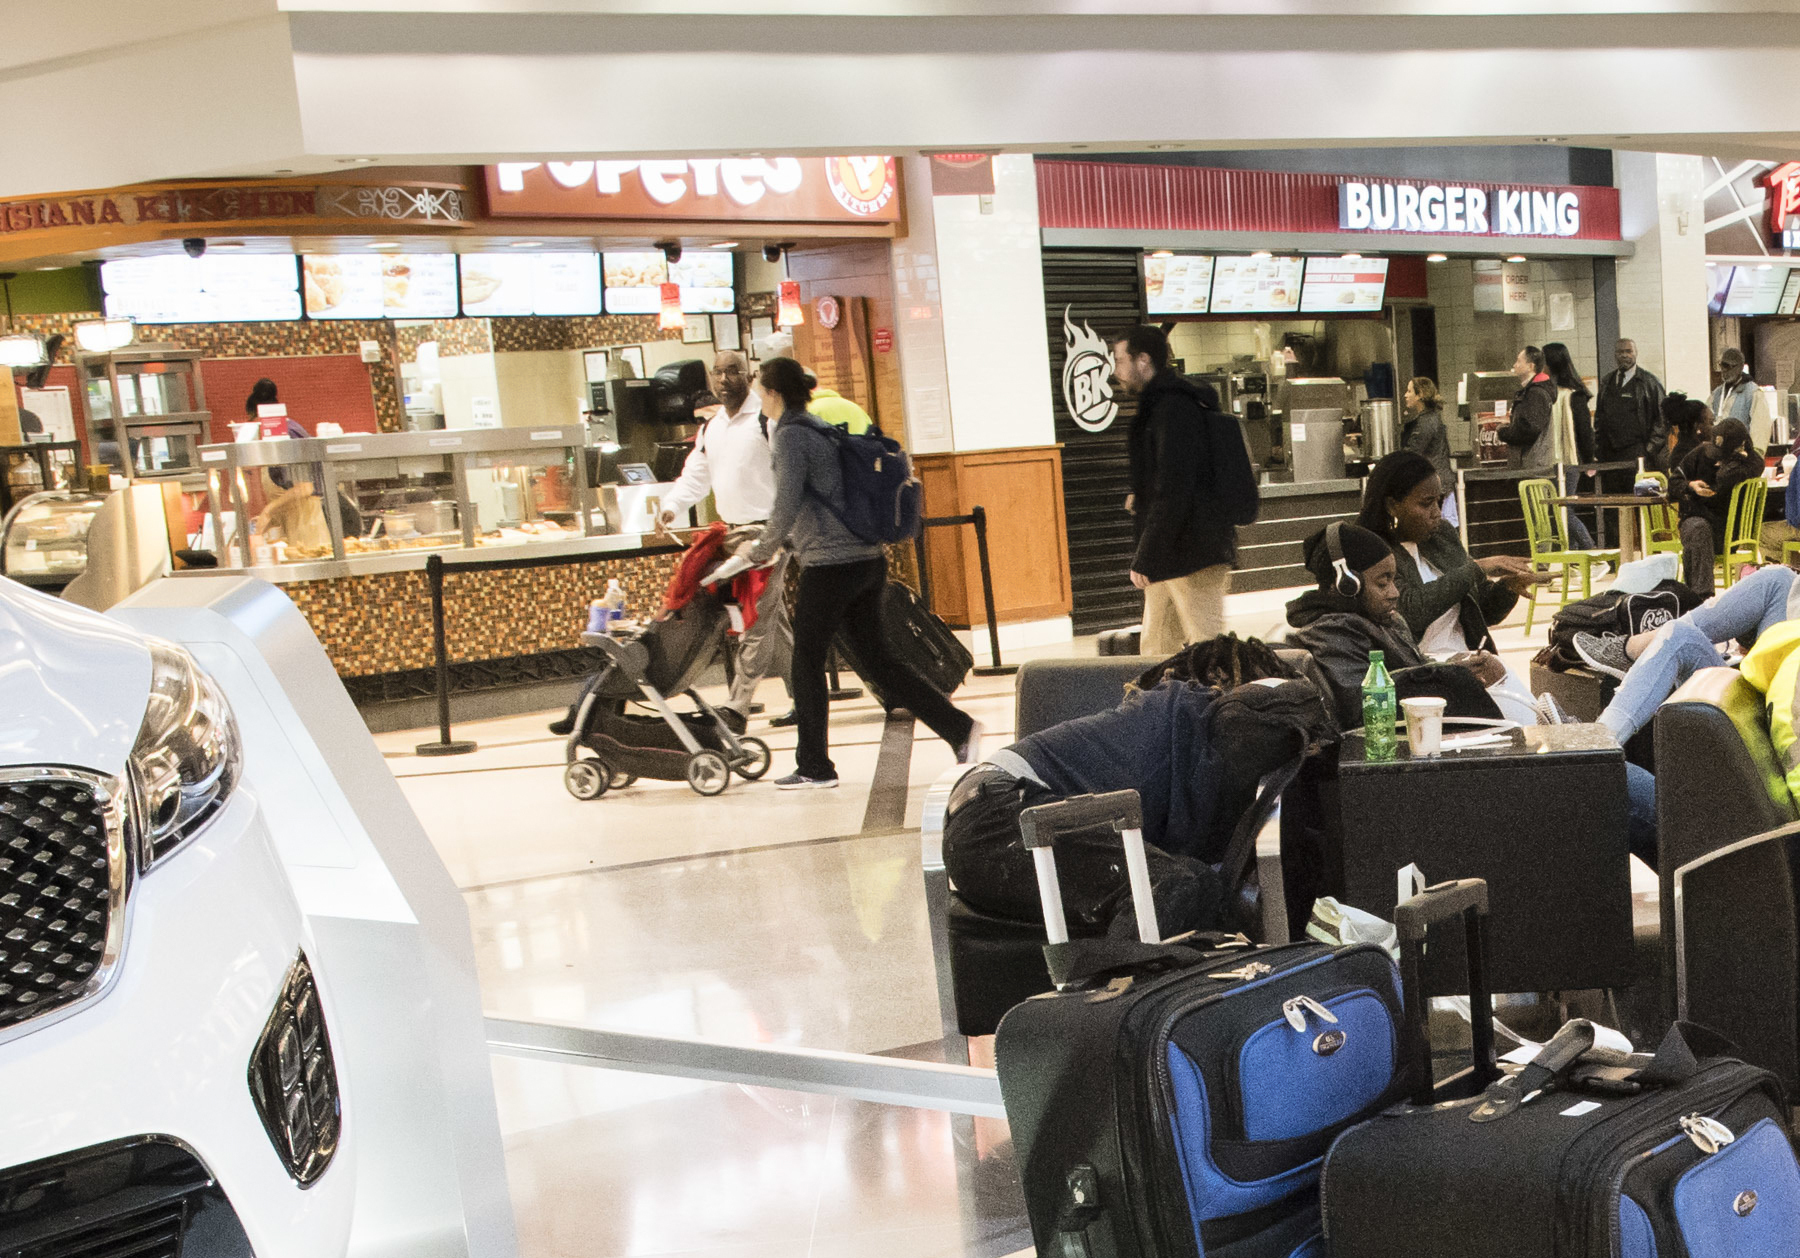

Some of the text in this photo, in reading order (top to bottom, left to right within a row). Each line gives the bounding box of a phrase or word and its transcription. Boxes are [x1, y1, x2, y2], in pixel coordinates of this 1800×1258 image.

[832, 182, 893, 214] KITCHEN
[1345, 182, 1580, 236] BURGER KING
[1506, 275, 1529, 285] ORDER
[1509, 292, 1528, 302] HERE
[1073, 362, 1113, 406] BK
